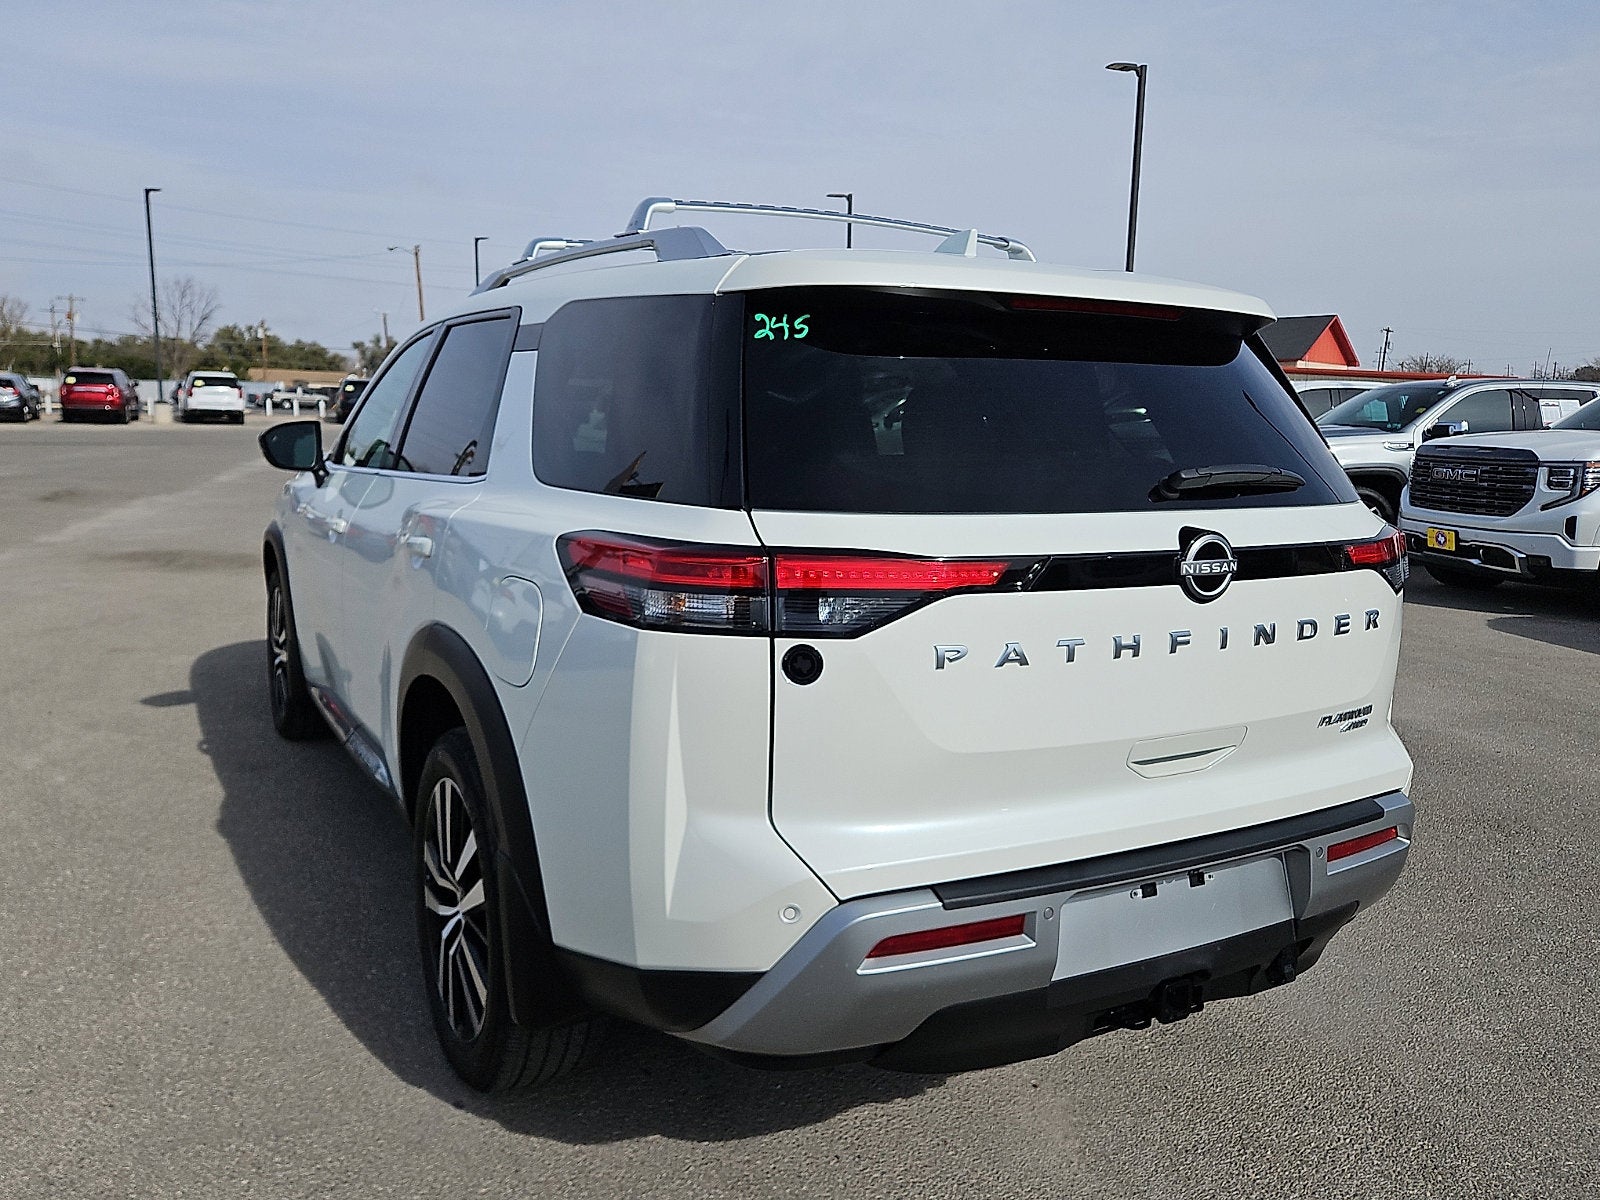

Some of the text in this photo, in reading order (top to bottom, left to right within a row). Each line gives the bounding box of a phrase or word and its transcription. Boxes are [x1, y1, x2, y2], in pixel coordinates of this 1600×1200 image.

[754, 313, 810, 340] 245
[1432, 468, 1476, 481] GMC
[1182, 561, 1238, 575] NISSAN
[933, 608, 1381, 671] PATHFINDER
